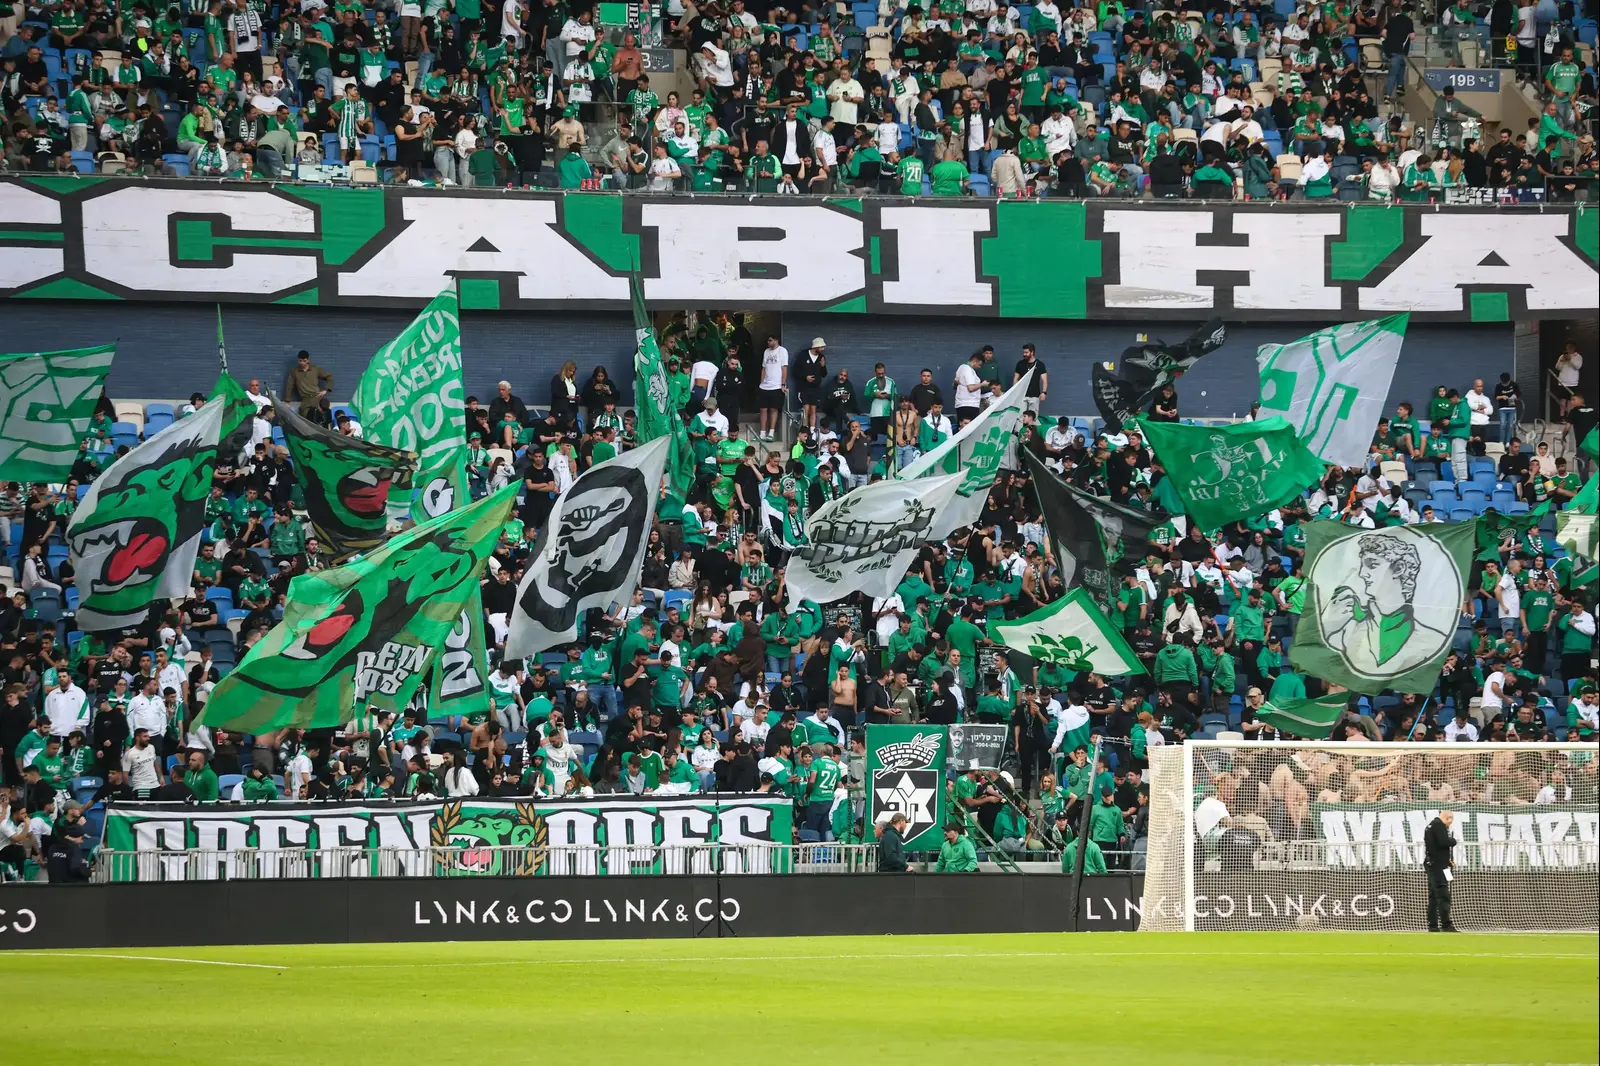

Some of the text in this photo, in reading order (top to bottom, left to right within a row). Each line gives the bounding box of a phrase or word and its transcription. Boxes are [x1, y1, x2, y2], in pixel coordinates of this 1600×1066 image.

[1449, 74, 1476, 87] 19B
[906, 168, 922, 182] 20
[0, 182, 992, 306] CABI
[819, 770, 837, 790] 24
